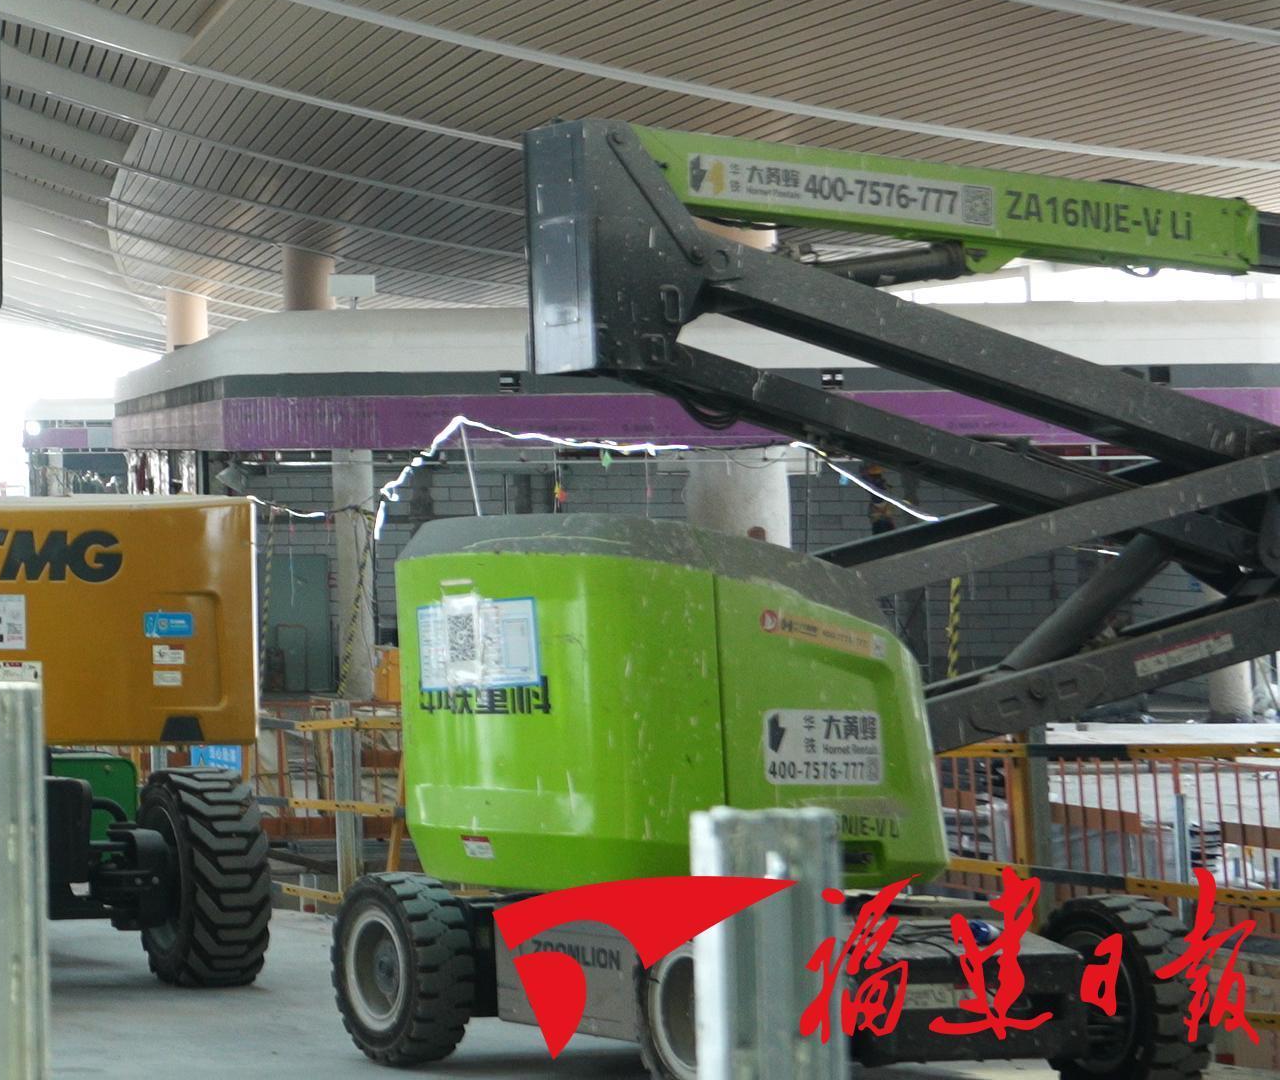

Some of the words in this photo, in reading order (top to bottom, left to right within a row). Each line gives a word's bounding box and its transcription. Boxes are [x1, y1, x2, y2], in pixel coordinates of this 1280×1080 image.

[745, 165, 800, 188] 大黄蜂
[804, 174, 959, 216] 400-7576-777
[1005, 190, 1161, 238] ZA16NJE-V
[1170, 210, 1194, 241] Li
[822, 715, 877, 740] 大黄蜂
[768, 761, 865, 780] 400-7576-777
